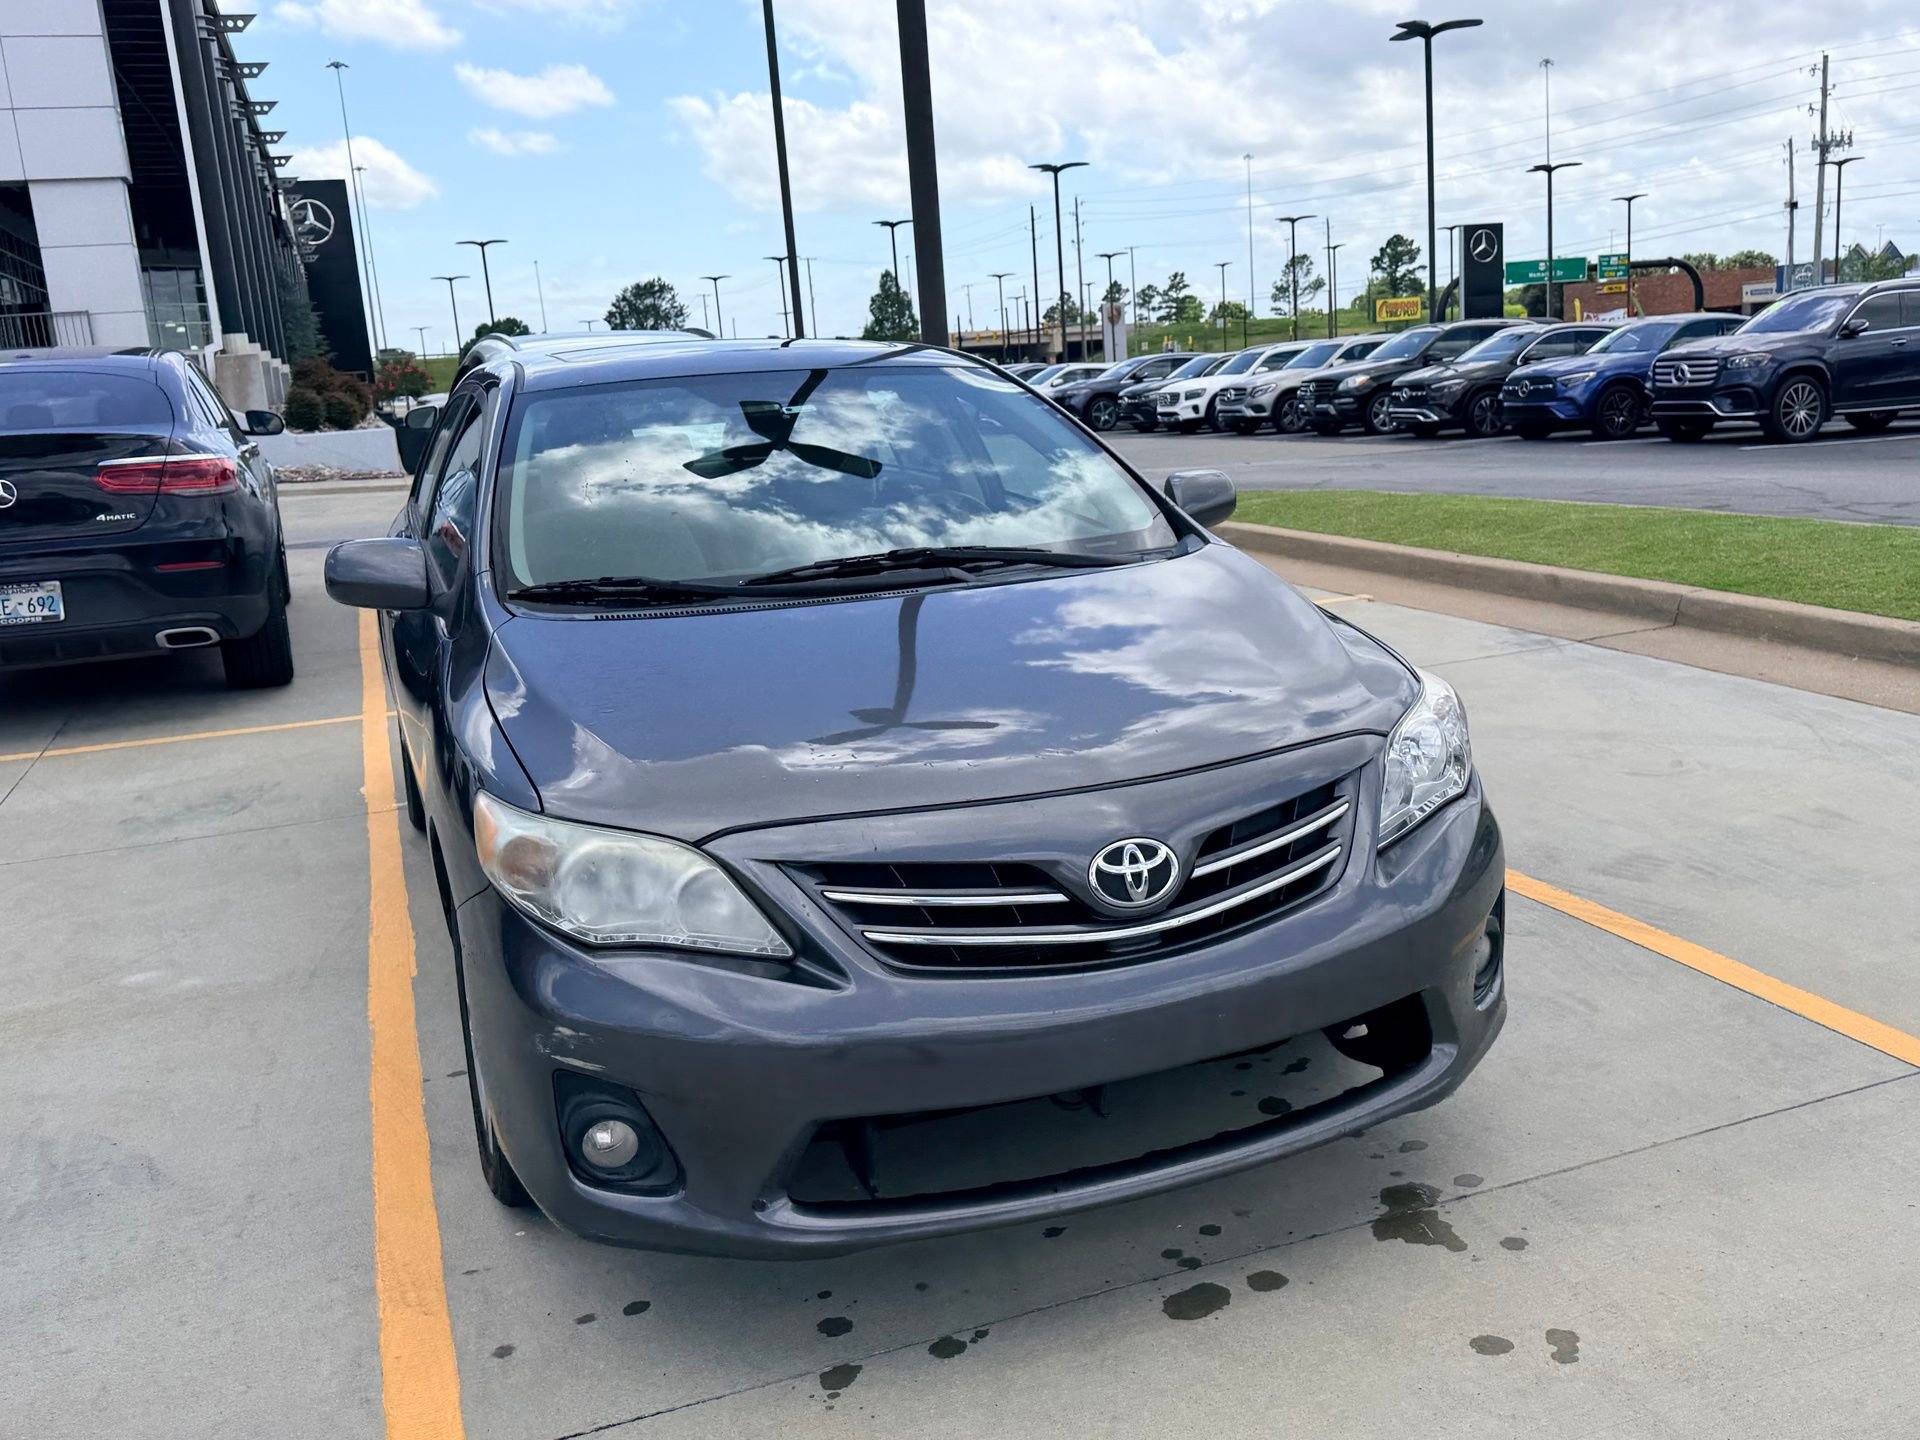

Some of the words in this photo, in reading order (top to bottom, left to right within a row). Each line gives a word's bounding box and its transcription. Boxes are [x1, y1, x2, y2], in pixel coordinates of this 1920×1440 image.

[1528, 270, 1555, 278] Memorl
[96, 512, 136, 521] 4MATIC
[0, 595, 56, 616] E-692
[0, 616, 43, 624] COOPER
